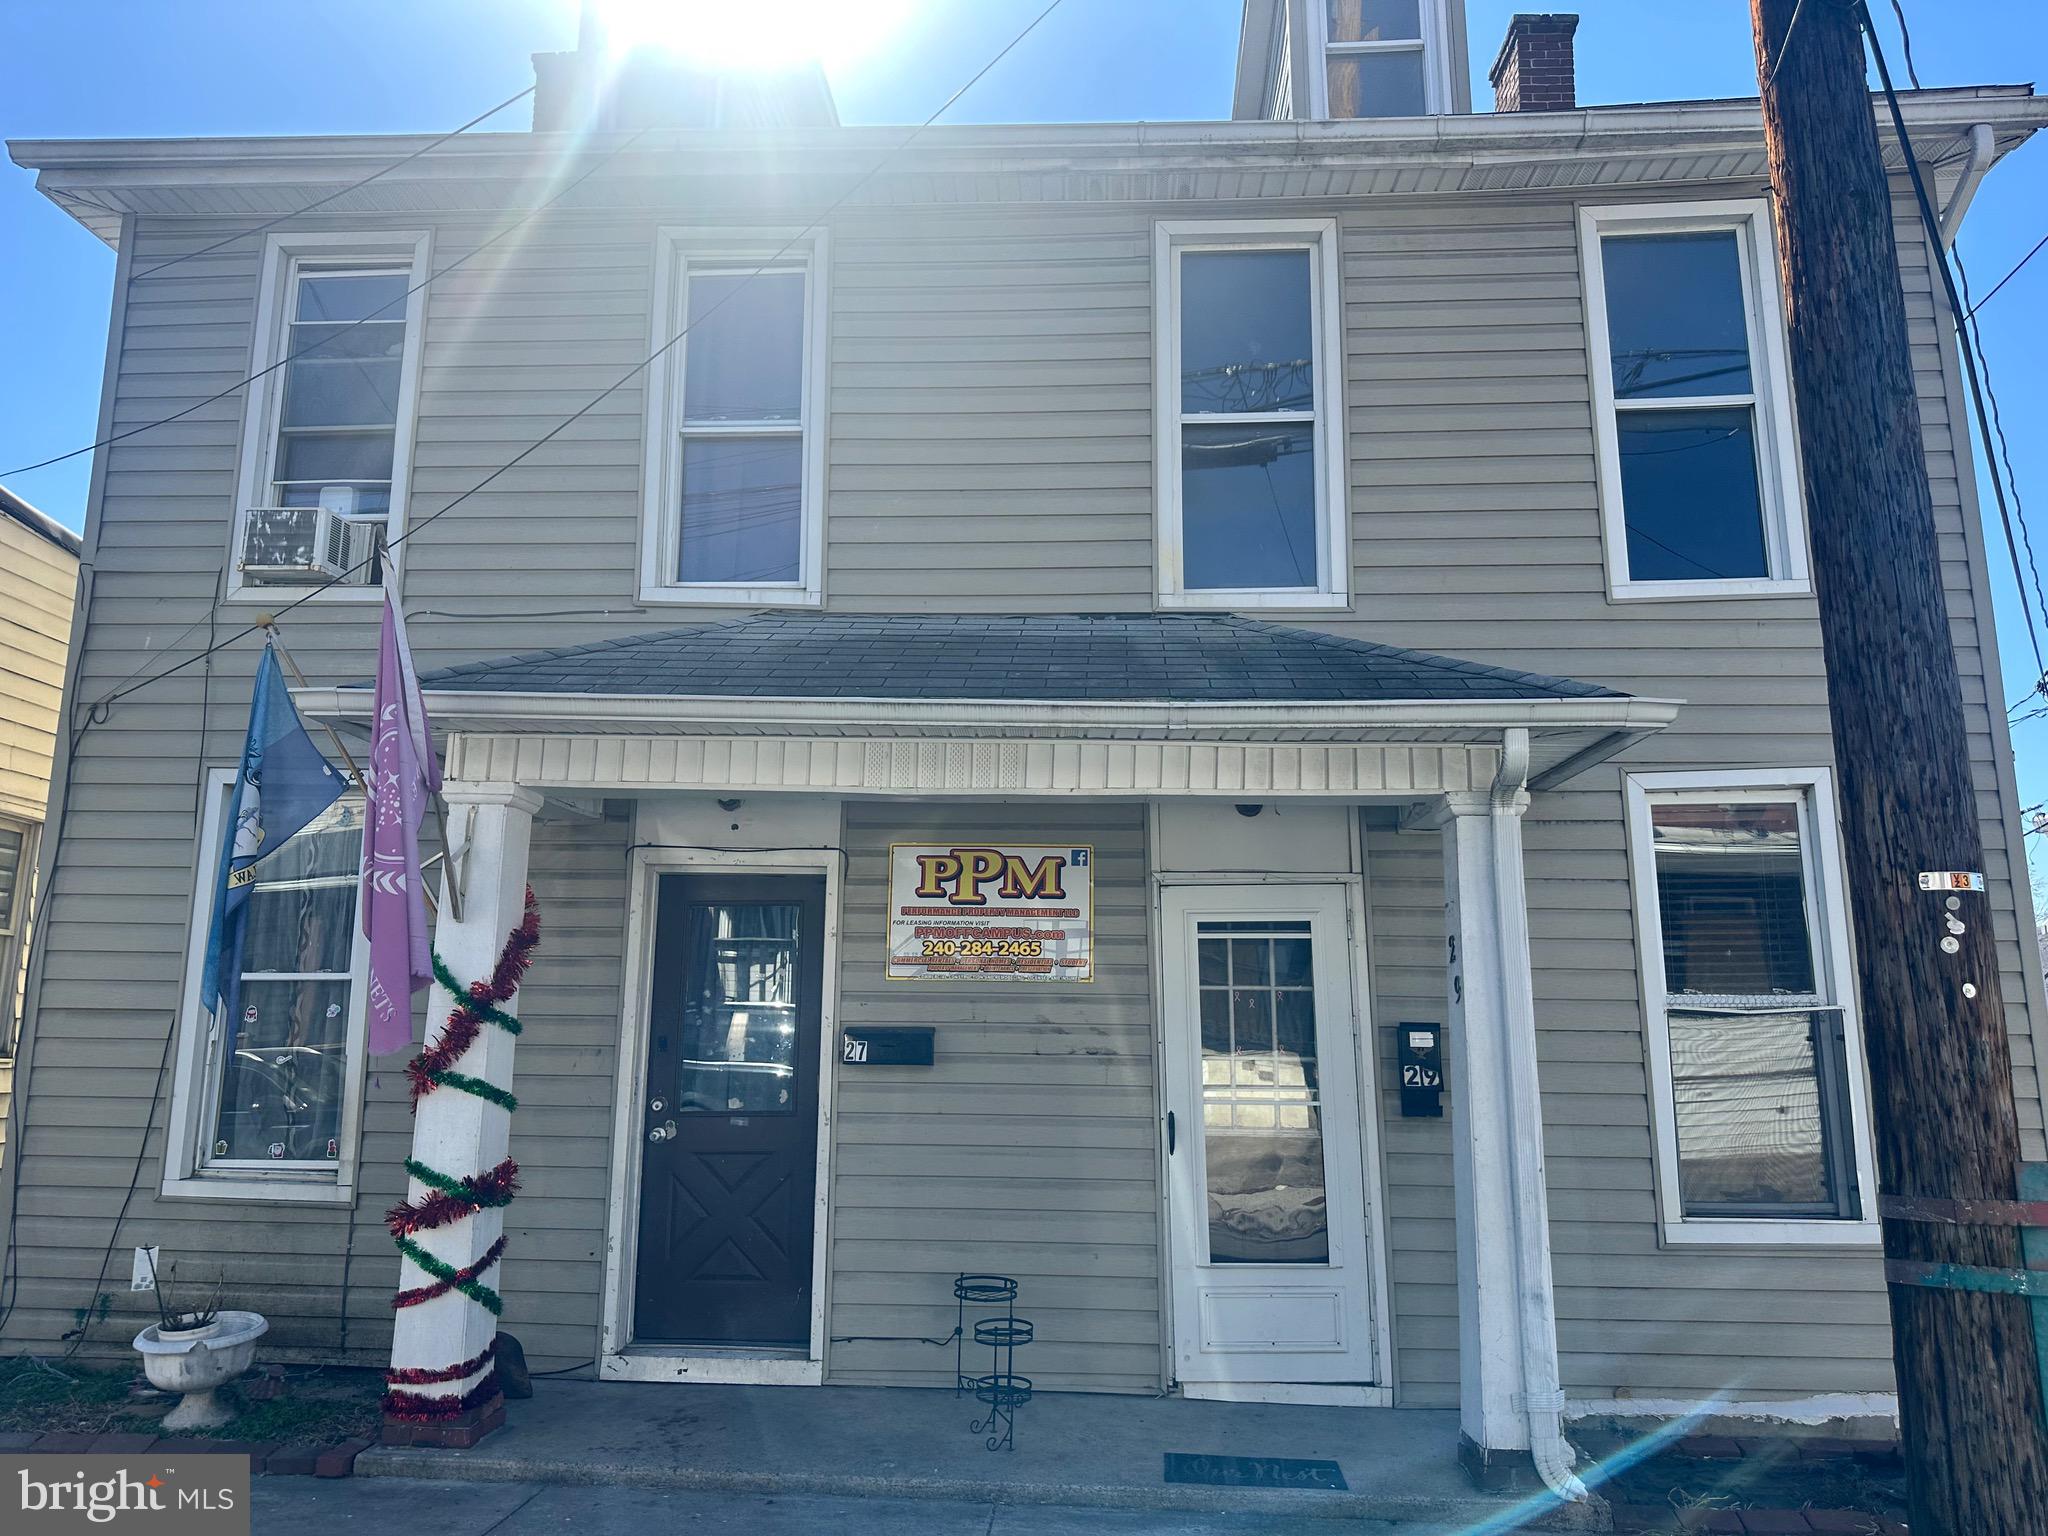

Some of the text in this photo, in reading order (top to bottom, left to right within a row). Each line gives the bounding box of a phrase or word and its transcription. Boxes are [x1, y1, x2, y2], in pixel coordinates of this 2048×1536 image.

[915, 849, 1066, 905] PPM
[1963, 875, 1969, 887] 3
[915, 927, 1065, 940] PPMOFFCAMPUS.com
[922, 940, 1042, 956] 240-284-2465
[845, 1042, 866, 1061] 27
